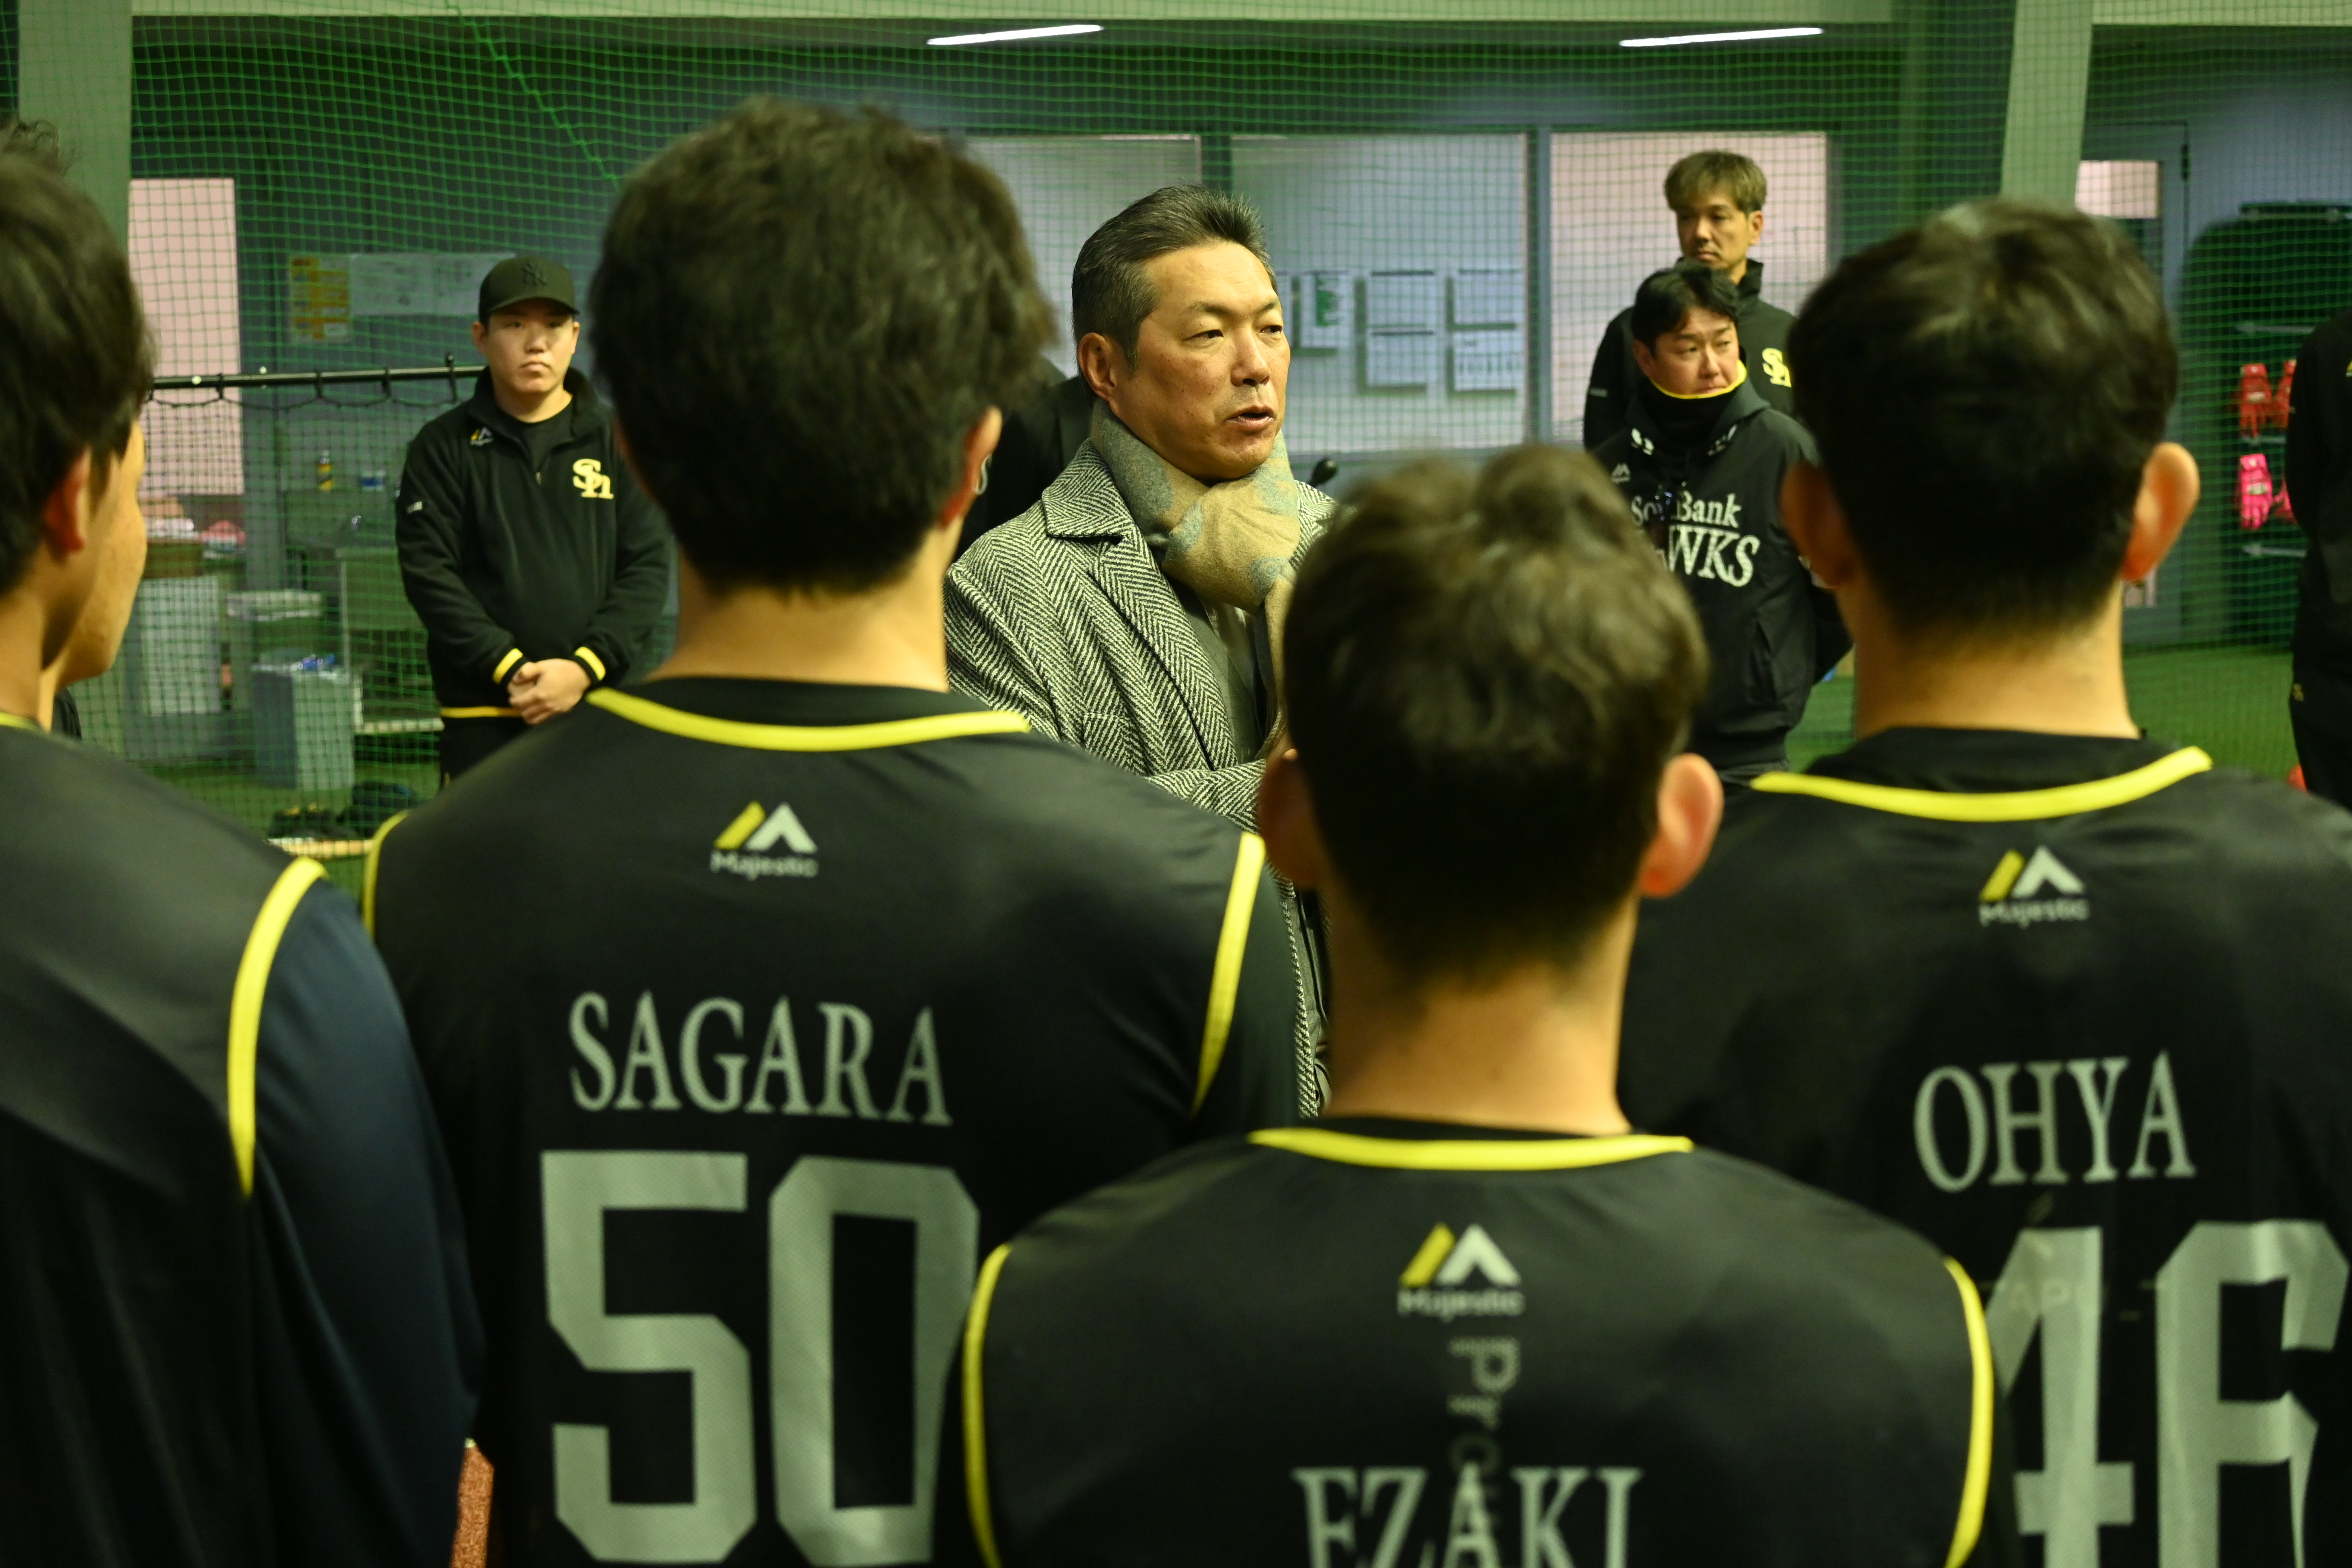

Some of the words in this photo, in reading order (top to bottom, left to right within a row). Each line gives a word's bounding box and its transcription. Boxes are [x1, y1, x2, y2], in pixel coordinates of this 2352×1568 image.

[1631, 490, 1742, 528] SoBank
[568, 990, 953, 1127] SAGARA
[1914, 1050, 2198, 1193] OHYA
[540, 1149, 980, 1568] 50
[1984, 1219, 2350, 1568] 46
